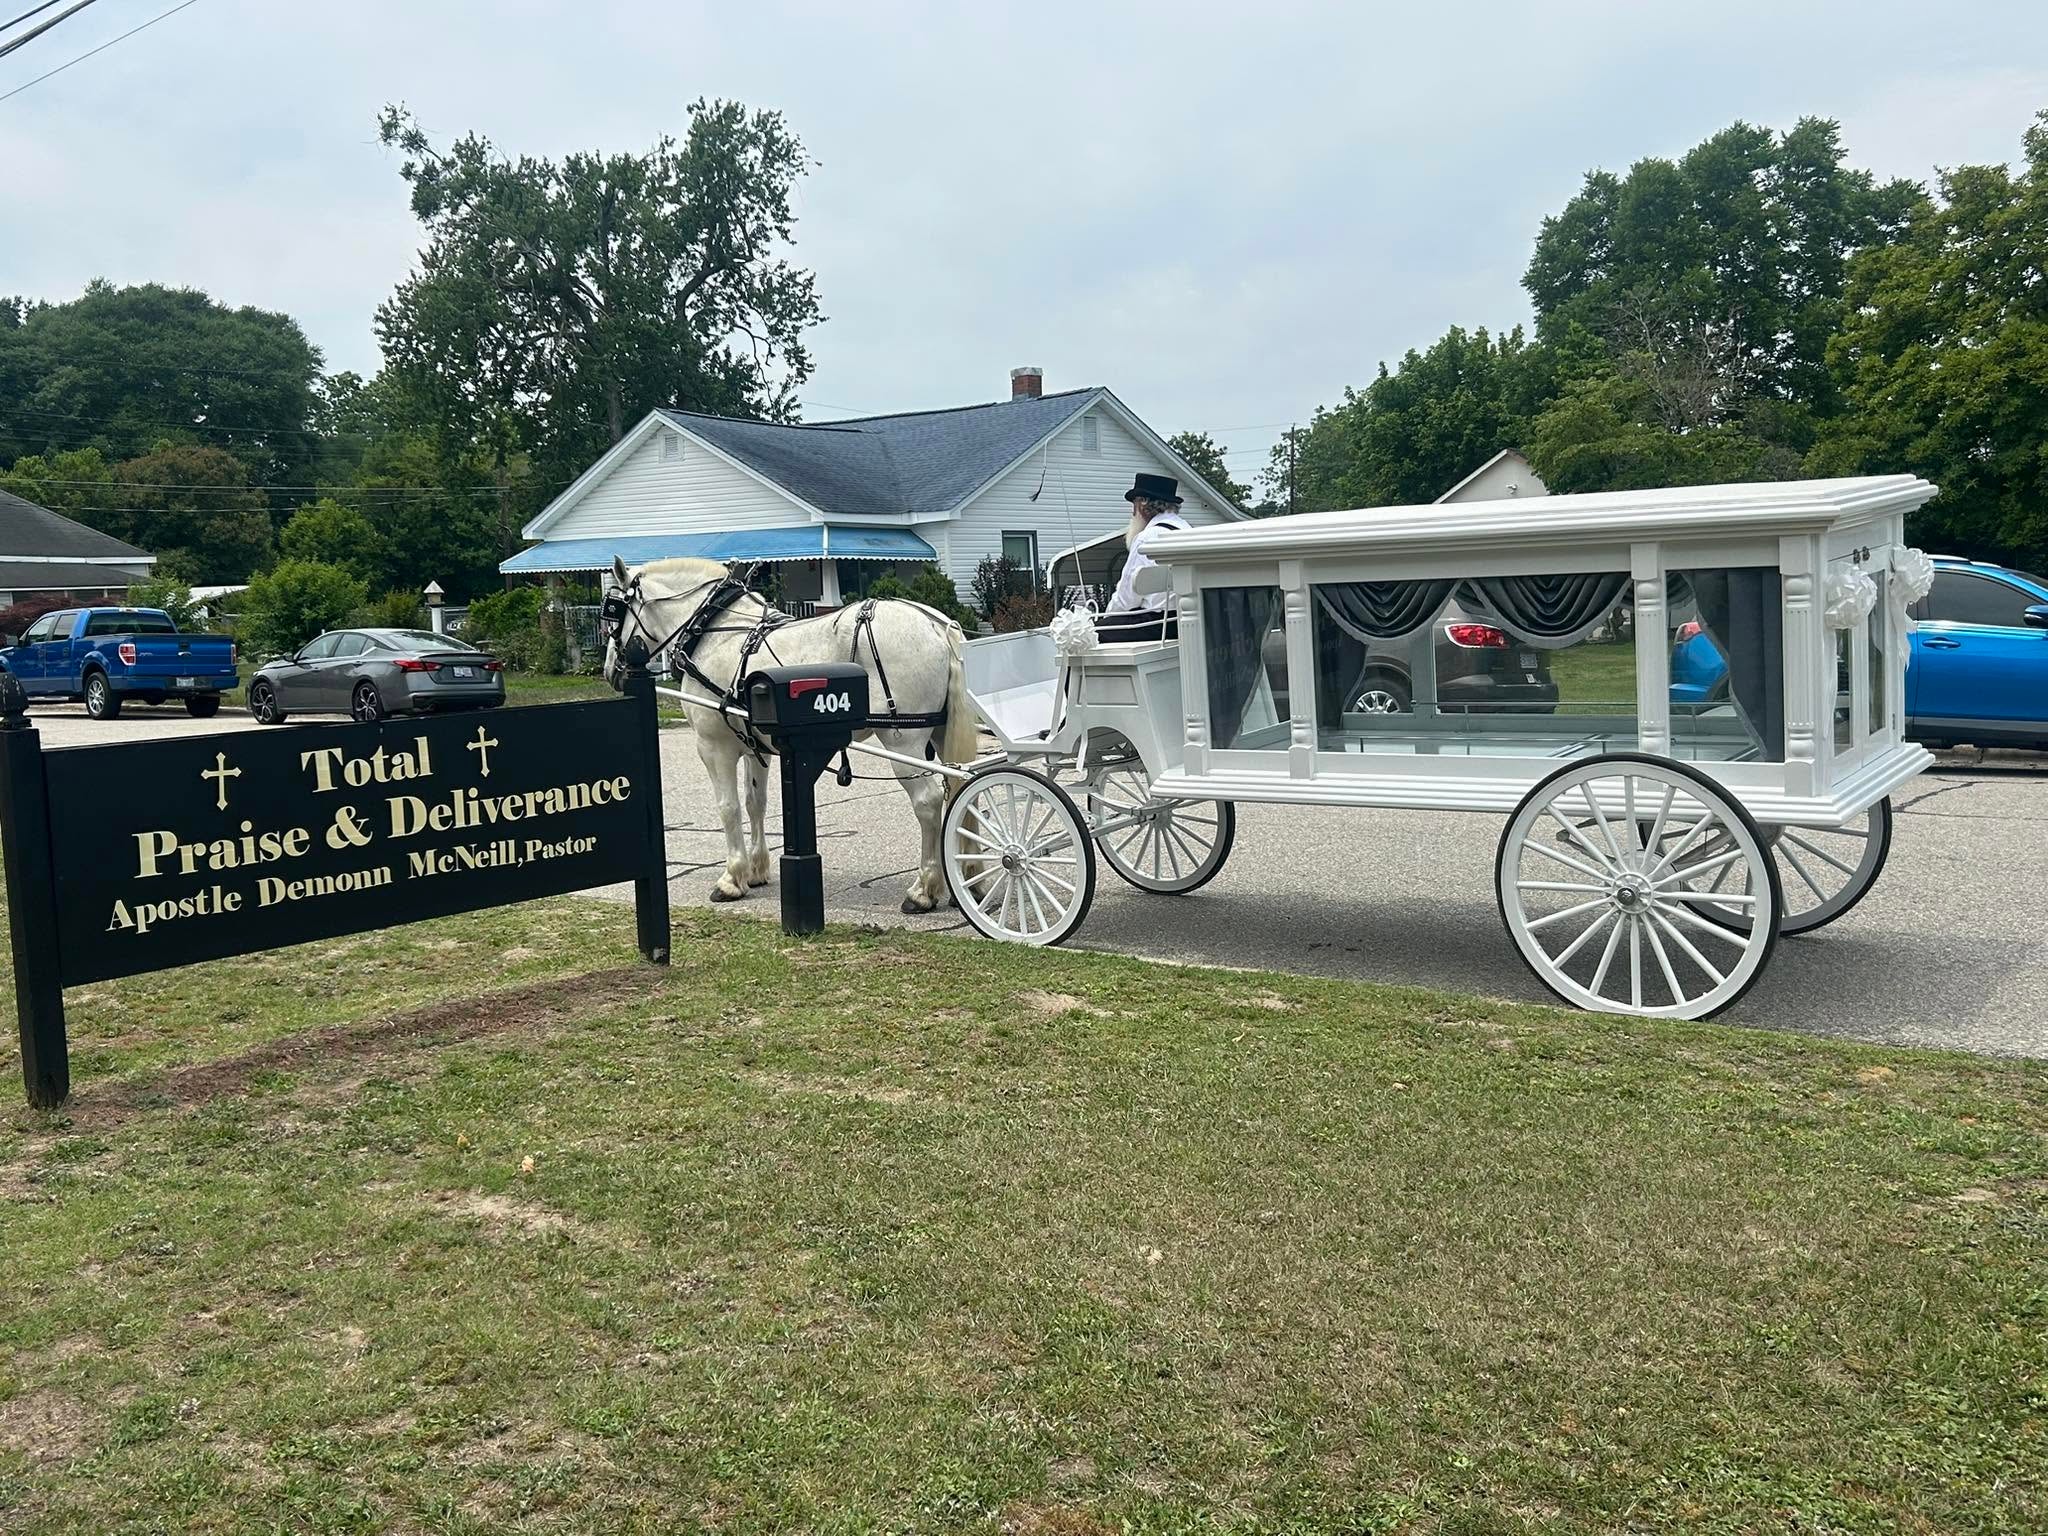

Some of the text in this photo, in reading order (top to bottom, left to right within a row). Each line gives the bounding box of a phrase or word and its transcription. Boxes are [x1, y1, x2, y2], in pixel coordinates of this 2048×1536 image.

[813, 692, 852, 713] 404
[300, 736, 434, 793] Total
[131, 776, 631, 879] Praise & Deliverance
[105, 885, 242, 935] Apostle
[257, 864, 393, 908] Demonn
